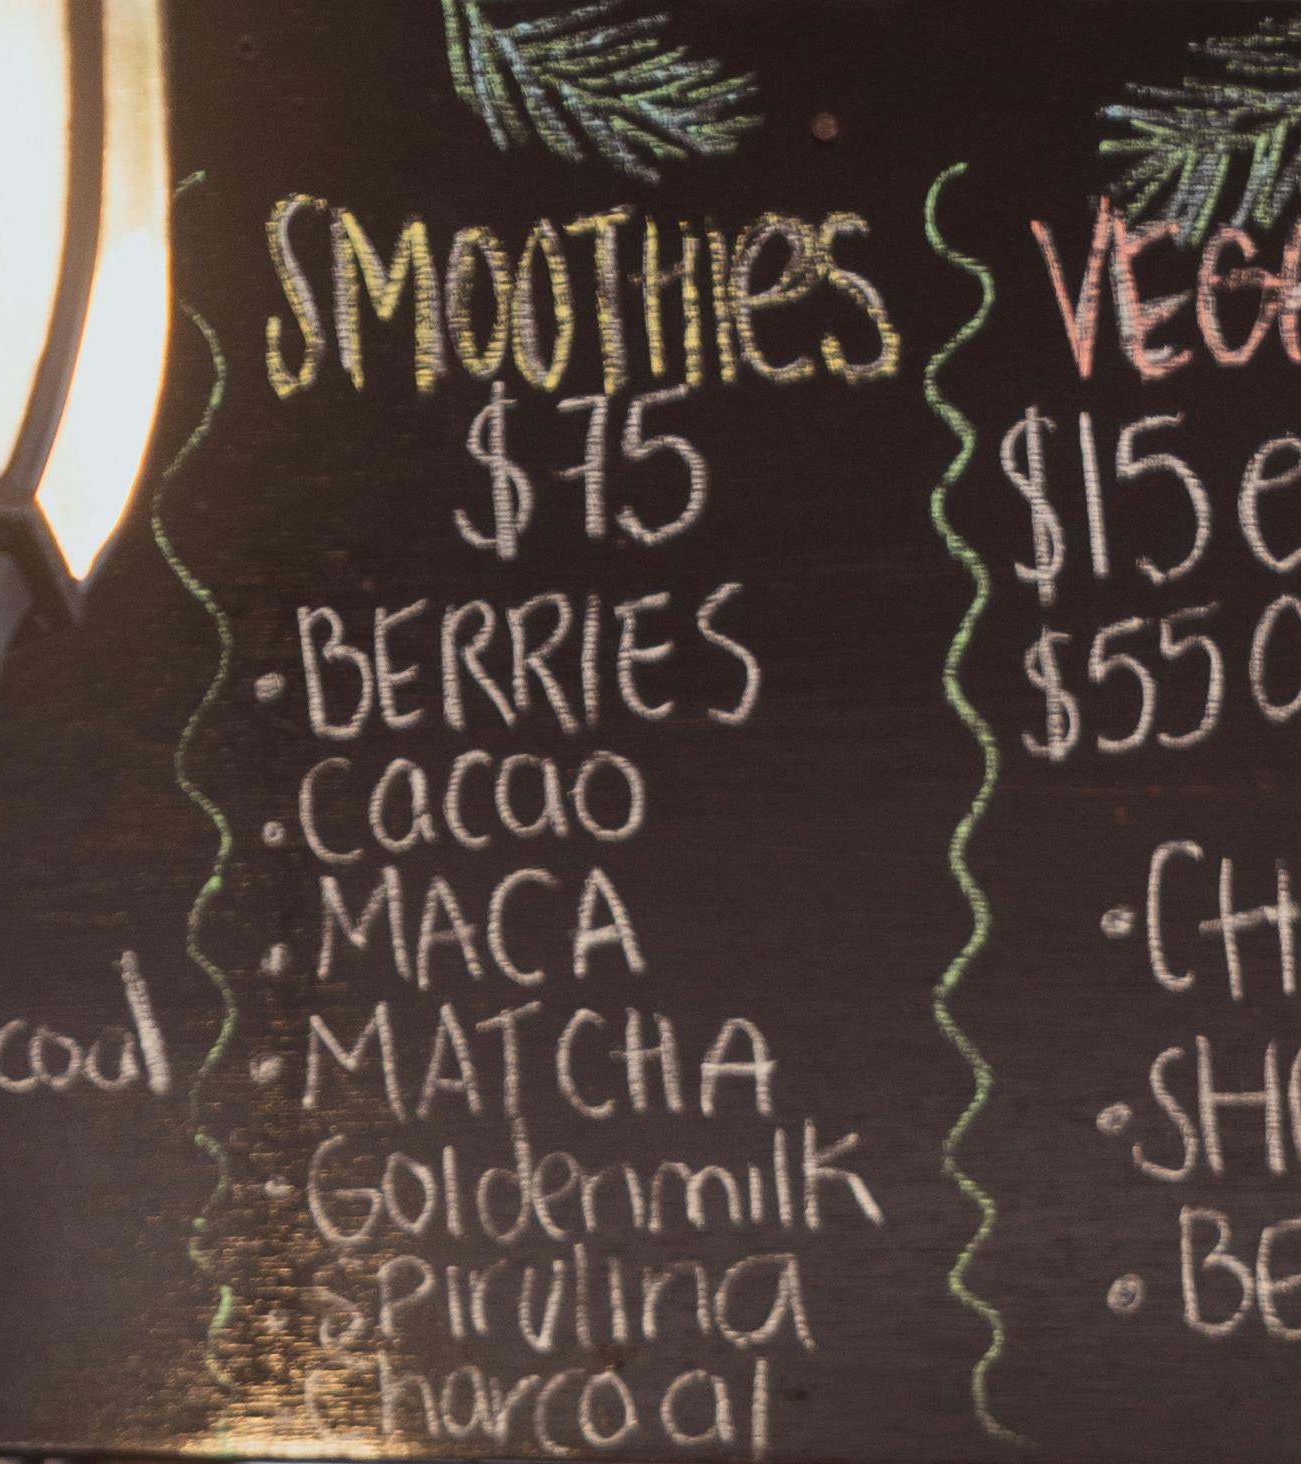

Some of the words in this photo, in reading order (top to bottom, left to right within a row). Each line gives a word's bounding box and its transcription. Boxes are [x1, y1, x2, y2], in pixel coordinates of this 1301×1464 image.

[455, 382, 706, 560] $75
[1001, 405, 1211, 602] $15
[298, 583, 762, 738] BERRIES
[1022, 603, 1225, 762] $55
[315, 865, 648, 990] MACA
[302, 1002, 776, 1120] MATCHA
[306, 1118, 885, 1245] Goldenmilk
